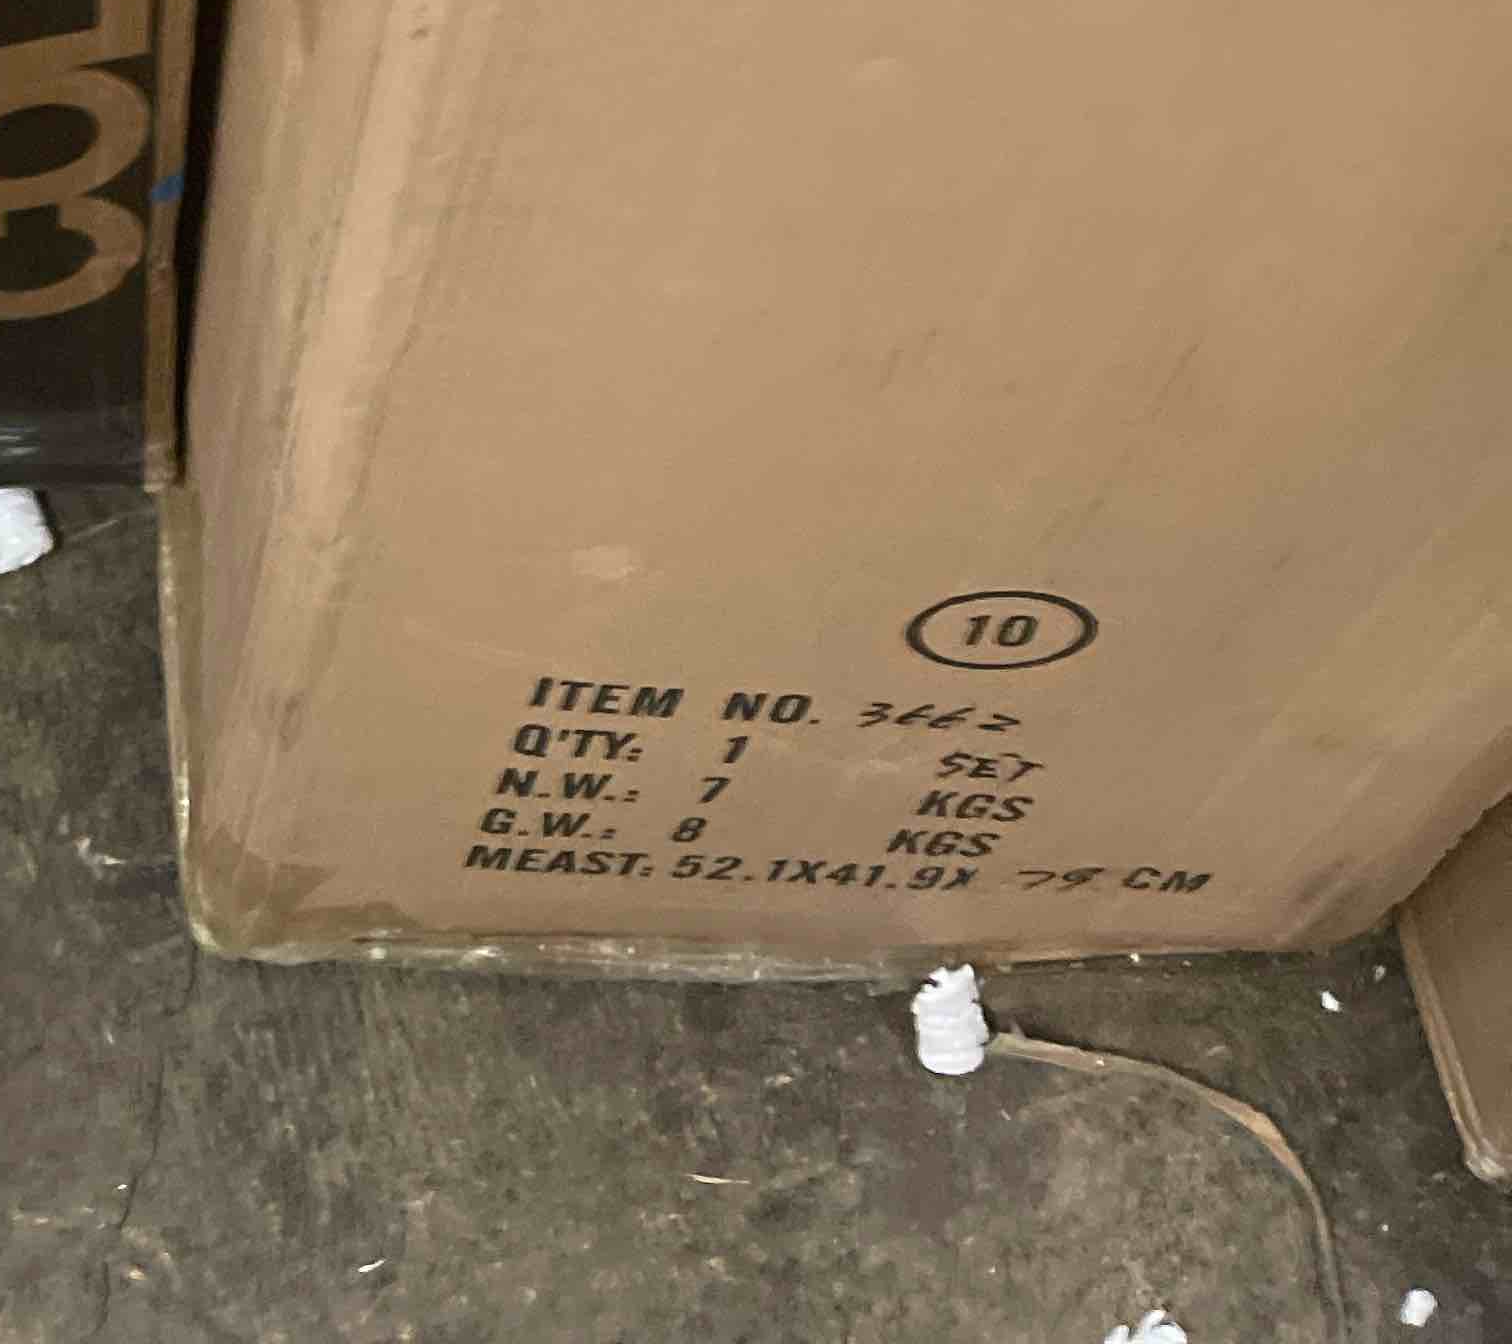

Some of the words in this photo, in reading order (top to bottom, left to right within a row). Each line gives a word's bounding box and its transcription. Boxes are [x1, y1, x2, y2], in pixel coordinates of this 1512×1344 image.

[963, 614, 1040, 648] 10
[528, 676, 685, 718] ITEM
[719, 692, 821, 723] NO.
[513, 723, 643, 762] Q'TY:
[721, 736, 749, 764] 1
[935, 750, 1045, 781] SET
[696, 776, 731, 804] 7
[915, 789, 1035, 821] KGS
[670, 817, 708, 842] 8
[886, 828, 1001, 856] KGS
[464, 844, 655, 878] MEAST:
[1120, 865, 1216, 894] CM
